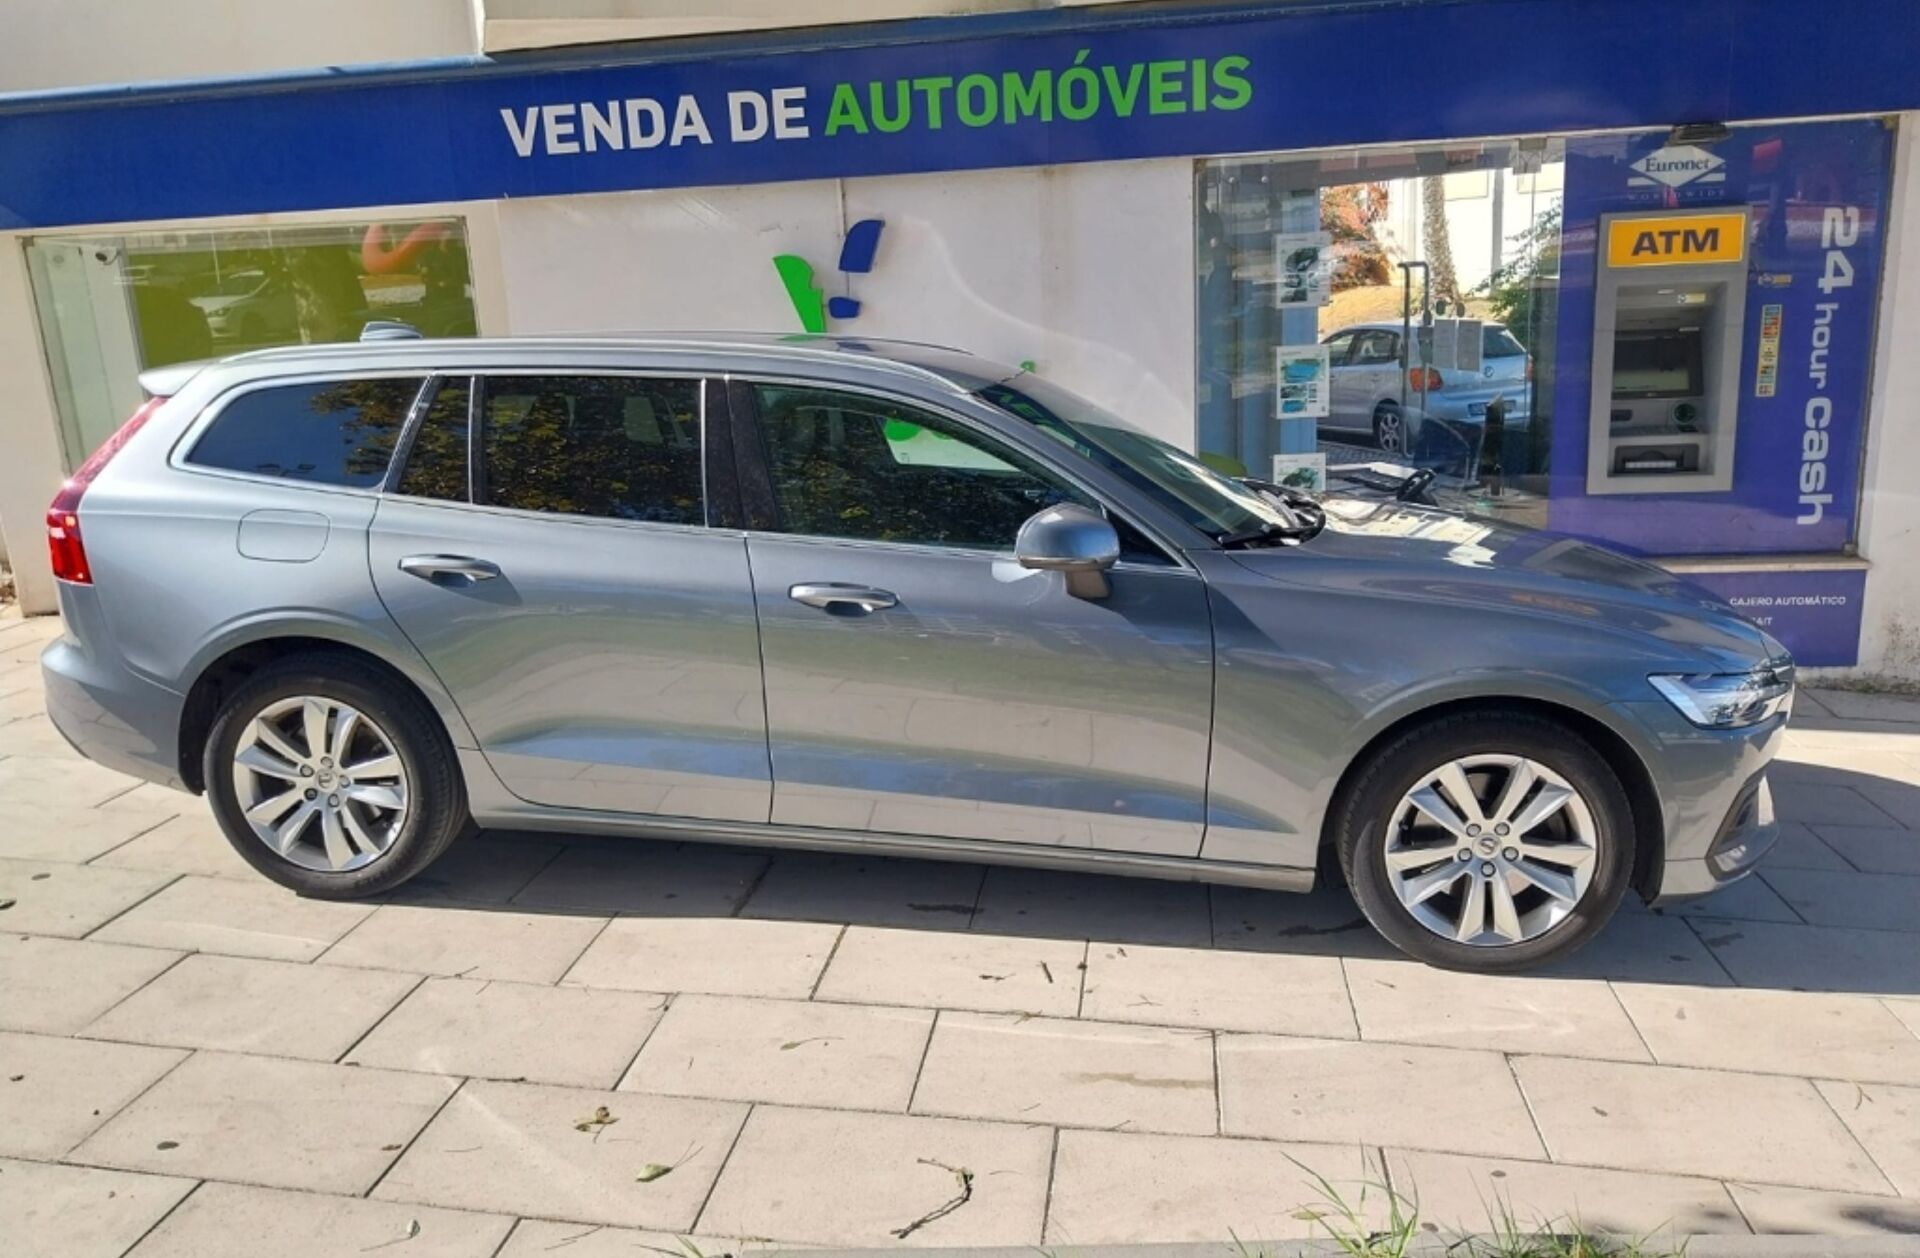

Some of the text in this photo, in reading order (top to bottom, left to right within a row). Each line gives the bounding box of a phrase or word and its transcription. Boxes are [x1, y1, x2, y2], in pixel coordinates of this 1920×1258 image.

[501, 49, 1253, 157] VENDA DE AUTOMÓVEIS
[1645, 158, 1712, 172] Euronet
[1627, 190, 1725, 200] WORDWIDE
[1631, 227, 1719, 256] ATM
[1796, 206, 1860, 525] 24 hour cash
[1730, 594, 1847, 606] CAJERO AUTOMÁTICO
